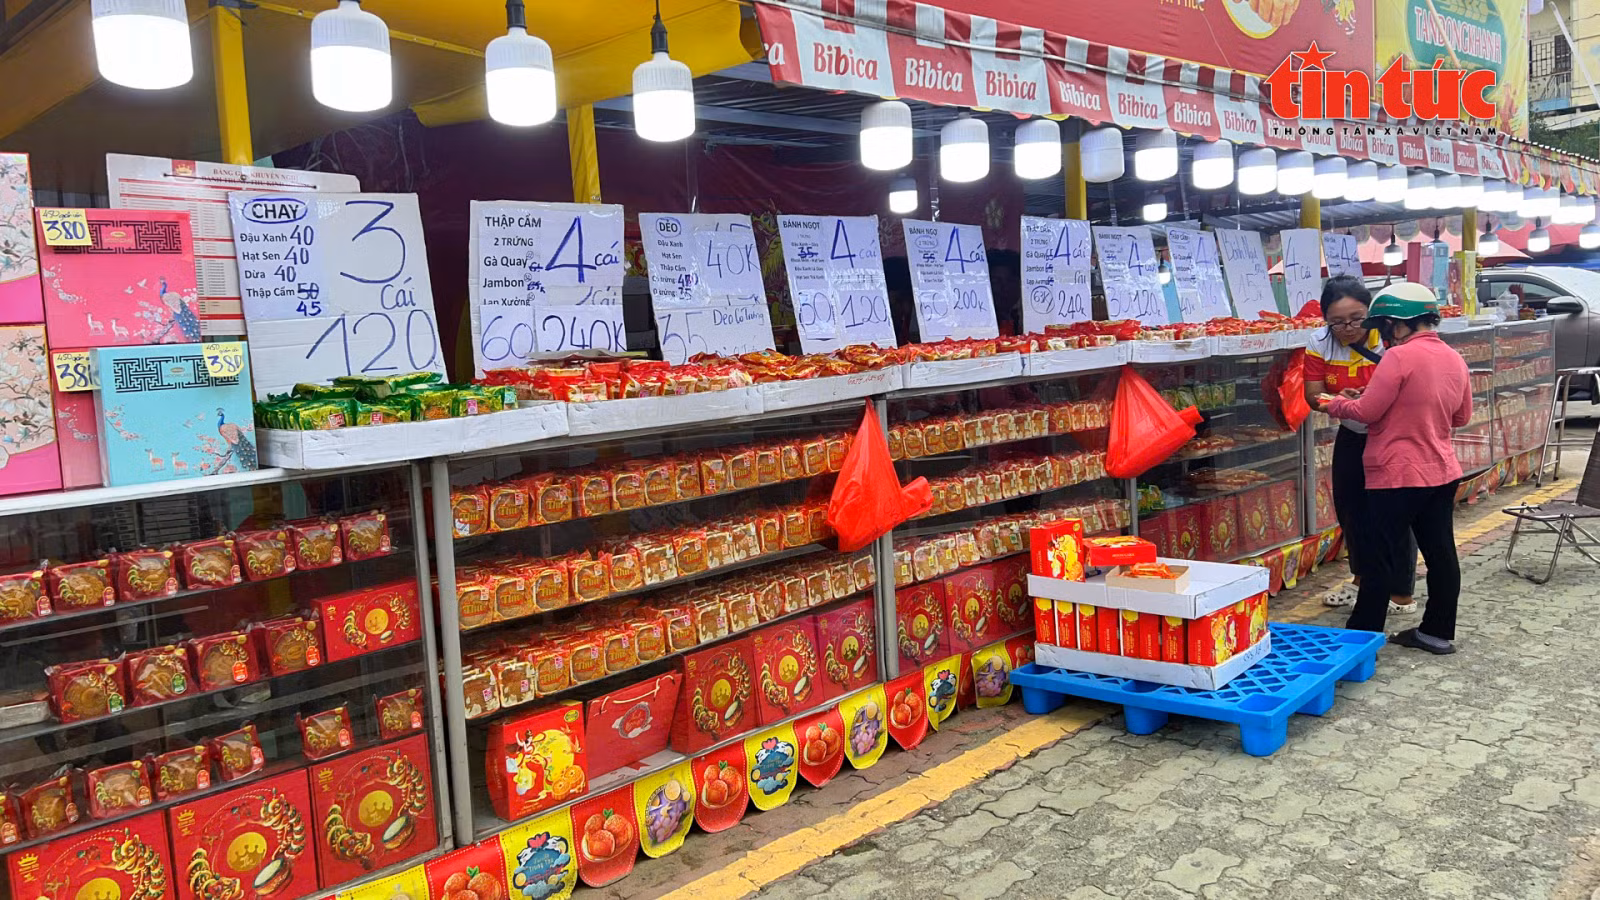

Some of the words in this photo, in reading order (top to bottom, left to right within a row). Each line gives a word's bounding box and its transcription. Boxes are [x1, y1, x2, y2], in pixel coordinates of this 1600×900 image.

[813, 42, 879, 81] Bibica
[905, 58, 963, 93] Bibica
[985, 71, 1037, 100] Bibica
[1058, 81, 1102, 111] Bibica
[1118, 93, 1158, 119] Bibica
[1173, 102, 1212, 127] Bibica
[1223, 110, 1257, 134] Bibica
[1340, 132, 1363, 152] Bibica
[1372, 136, 1394, 156] Bibica
[1402, 143, 1423, 160] Bibica
[1430, 147, 1449, 164] Bibica
[1457, 151, 1475, 168] Bibica
[251, 203, 299, 219] CHAY
[43, 220, 85, 241] 380
[484, 213, 515, 230] THẬP
[659, 219, 678, 233] DẺO
[782, 219, 802, 229] BÁNH
[802, 221, 820, 231] NGỌT
[909, 226, 925, 235] BÁNH
[240, 233, 260, 243] Đậu
[262, 233, 288, 242] Xanh
[290, 225, 314, 246] 40
[340, 200, 406, 284] 3
[494, 237, 500, 246] 2
[501, 235, 534, 247] TRỨNG
[657, 239, 669, 248] Đậu
[669, 240, 684, 248] Xanh
[831, 219, 856, 269] 4
[1054, 224, 1071, 266] 4
[242, 252, 260, 263] Hạt
[262, 252, 280, 261] Sen
[283, 246, 310, 265] 40
[545, 215, 597, 283] 4
[661, 252, 672, 260] Hạt
[945, 226, 977, 273] 4
[1026, 250, 1034, 258] Gà
[1128, 240, 1144, 276] 4
[1285, 236, 1299, 281] 4
[1341, 238, 1352, 267] 4
[483, 256, 498, 267] Gà
[500, 256, 528, 269] Quay
[660, 263, 674, 272] Thập
[1026, 265, 1045, 273] Jambon
[244, 269, 266, 279] Dừa
[274, 265, 297, 283] 40
[483, 277, 524, 288] Jambon
[246, 287, 271, 299] Thập
[296, 301, 322, 317] 45
[481, 315, 534, 361] 60
